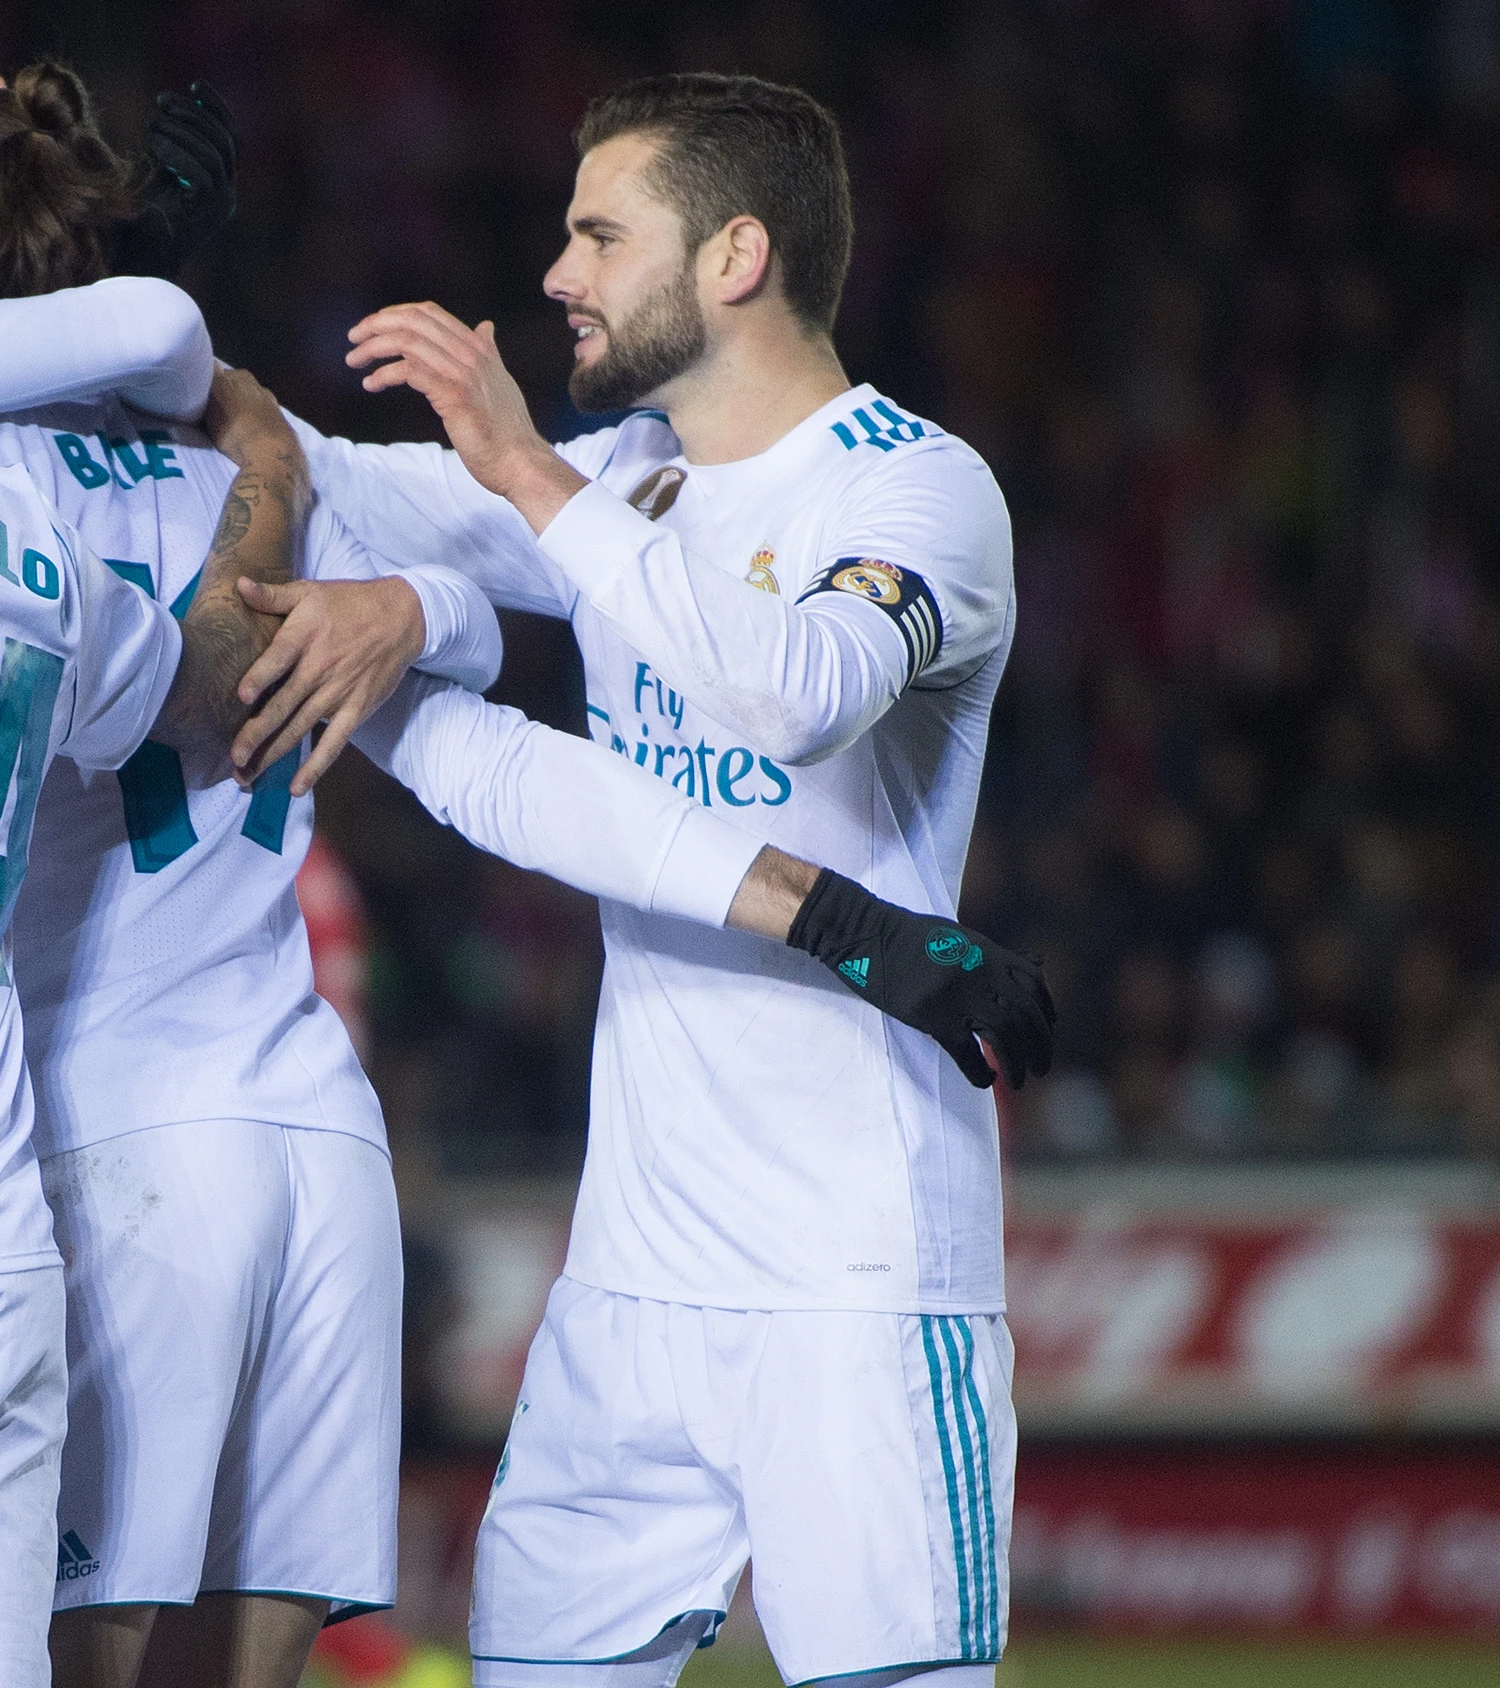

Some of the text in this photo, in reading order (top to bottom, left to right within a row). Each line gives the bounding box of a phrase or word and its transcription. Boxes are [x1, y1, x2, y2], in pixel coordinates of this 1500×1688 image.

[634, 661, 684, 730] Fly
[838, 963, 868, 988] adidas
[846, 1262, 891, 1272] adizero
[57, 1560, 101, 1581] idas
